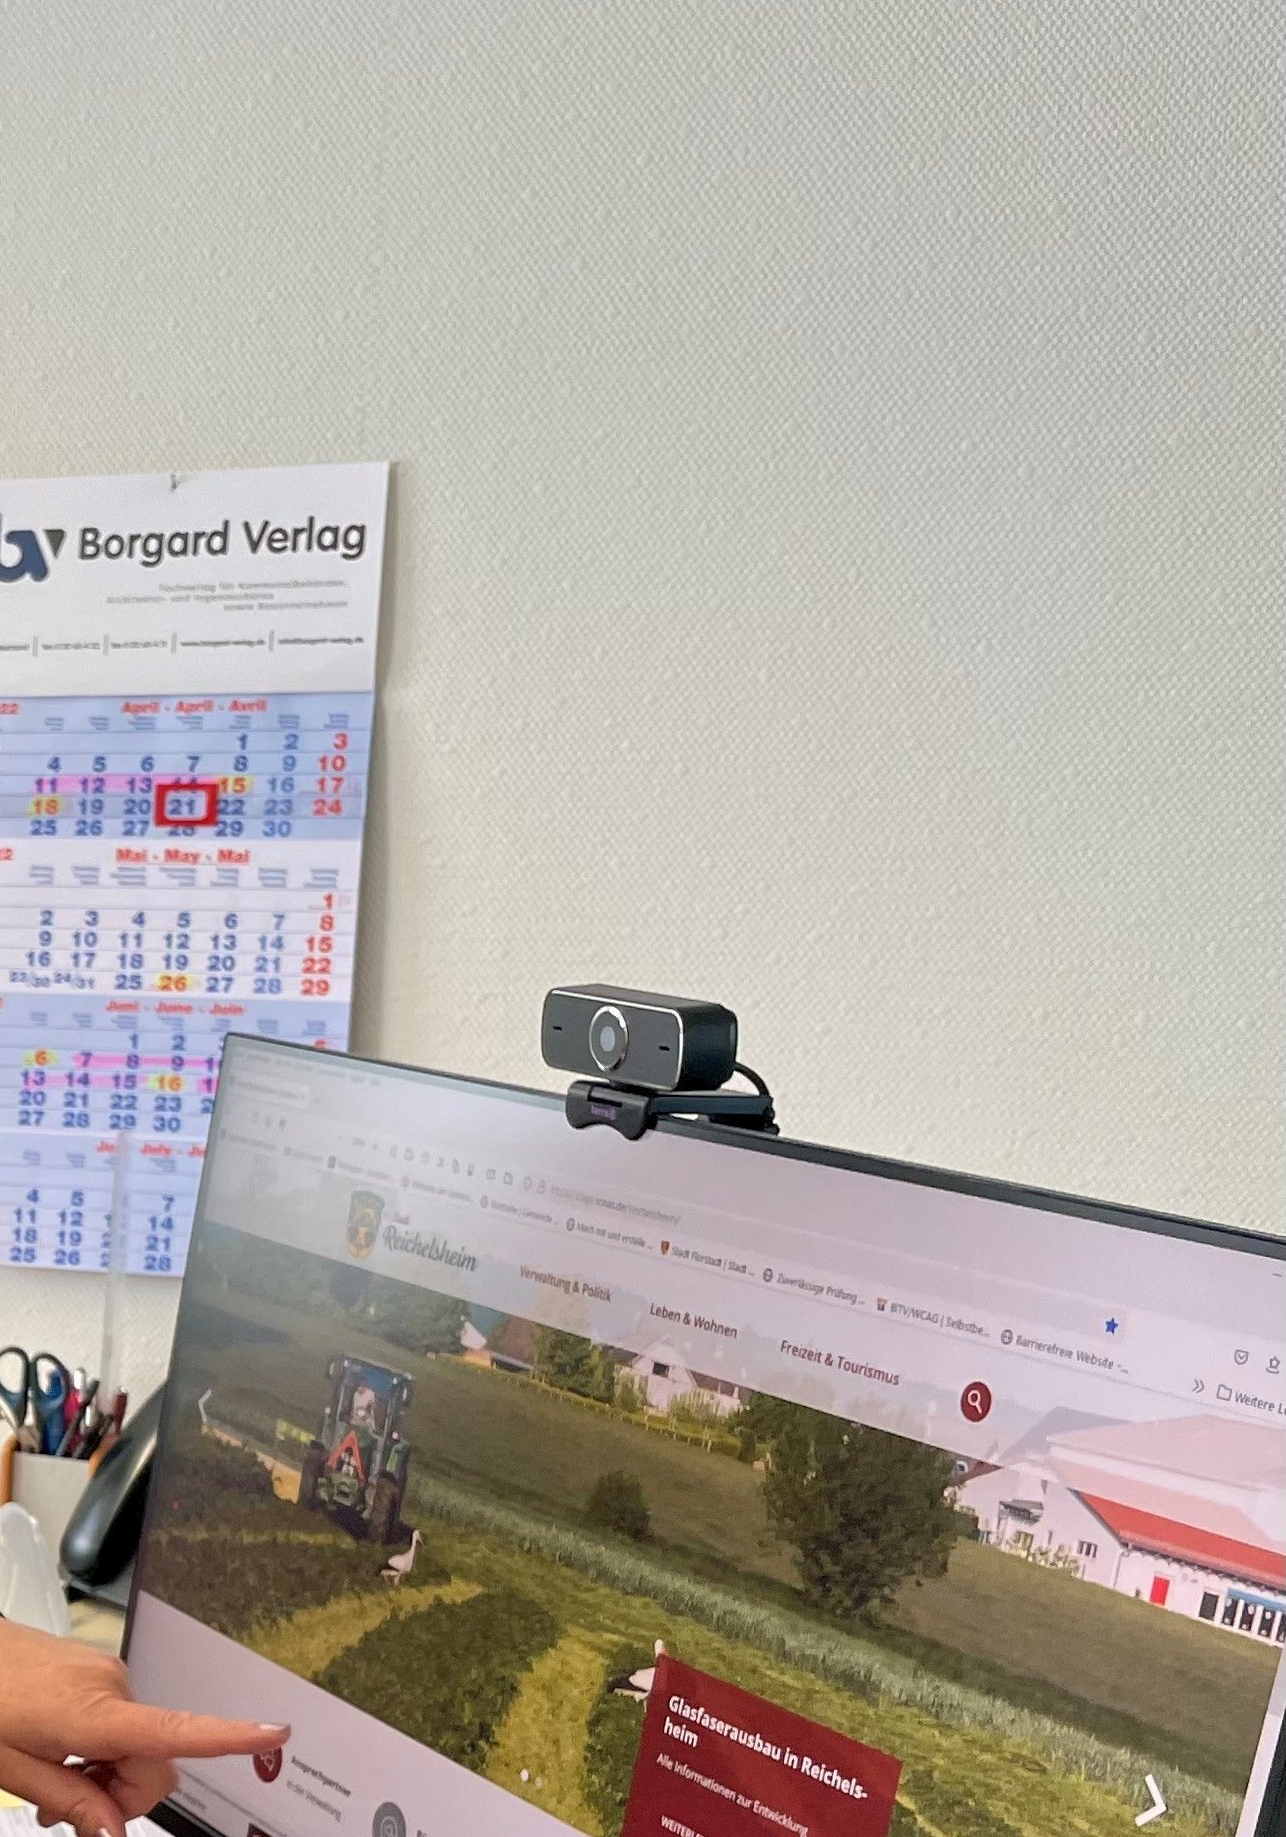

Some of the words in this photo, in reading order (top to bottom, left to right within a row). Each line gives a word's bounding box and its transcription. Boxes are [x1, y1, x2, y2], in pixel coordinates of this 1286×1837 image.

[78, 520, 230, 568] Borgard
[243, 515, 367, 560] Verlag
[122, 701, 159, 718] April
[176, 700, 214, 716] April
[230, 699, 268, 712] Avril
[236, 734, 248, 751] 1
[284, 733, 300, 751] 2
[333, 733, 349, 750] 3
[47, 756, 62, 773] 4
[93, 756, 107, 773] 5
[140, 756, 156, 773] 6
[187, 756, 201, 773] 7
[233, 755, 249, 773] 8
[282, 755, 297, 772] 9
[317, 755, 347, 771] 10
[34, 777, 59, 794] 11
[80, 777, 105, 794] 12
[128, 777, 153, 794] 13
[219, 777, 246, 794] 15
[268, 777, 295, 794] 16
[317, 777, 345, 794] 17
[33, 798, 59, 816] 18
[79, 798, 104, 816] 19
[124, 798, 151, 816] 20
[168, 799, 196, 816] 21
[218, 799, 246, 816] 22
[264, 799, 293, 816] 23
[313, 799, 343, 817] 24
[30, 819, 58, 837] 25
[75, 820, 103, 837] 26
[122, 820, 150, 837] 27
[215, 820, 244, 837] 29
[263, 820, 292, 837] 30
[116, 848, 148, 862] Mai
[165, 848, 200, 865] May
[217, 847, 251, 863] Mai
[324, 894, 335, 909] 1
[40, 910, 54, 927] 2
[85, 910, 99, 927] 3
[132, 912, 146, 928] 4
[177, 912, 191, 928] 5
[223, 913, 238, 929] 6
[272, 914, 285, 931] 7
[319, 915, 334, 931] 8
[39, 931, 52, 947] 9
[72, 932, 98, 948] 10
[119, 933, 143, 949] 11
[163, 933, 190, 950] 12
[210, 934, 237, 950] 13
[257, 935, 284, 952] 14
[305, 936, 333, 953] 15
[26, 951, 52, 967] 16
[72, 952, 96, 968] 17
[118, 953, 143, 970] 18
[162, 954, 189, 970] 19
[207, 955, 236, 972] 20
[254, 956, 282, 973] 21
[302, 957, 332, 974] 22
[115, 974, 142, 990] 25
[159, 975, 187, 991] 26
[205, 976, 234, 993] 27
[253, 978, 282, 995] 28
[300, 979, 329, 996] 29
[106, 1000, 140, 1013] Juni
[154, 1002, 193, 1015] June
[128, 1033, 139, 1049] 1
[171, 1035, 185, 1051] 2
[34, 1050, 47, 1066] 6
[80, 1052, 92, 1068] 7
[126, 1053, 140, 1069] 8
[170, 1055, 185, 1071] 9
[21, 1069, 46, 1086] 13
[66, 1071, 90, 1088] 14
[112, 1073, 137, 1090] 15
[157, 1075, 182, 1092] 16
[18, 1090, 45, 1107] 20
[63, 1092, 89, 1108] 21
[109, 1094, 137, 1110] 22
[154, 1096, 182, 1113] 23
[17, 1110, 45, 1127] 27
[62, 1112, 90, 1128] 28
[109, 1114, 136, 1131] 29
[153, 1116, 181, 1133] 30
[141, 1143, 173, 1158] July
[26, 1188, 39, 1203] 4
[70, 1190, 84, 1206] 5
[162, 1196, 174, 1212] 7
[13, 1208, 37, 1224] 11
[58, 1210, 83, 1227] 12
[148, 1215, 174, 1231] 14
[12, 1227, 37, 1243] 18
[57, 1230, 82, 1246] 19
[144, 1235, 171, 1252] 21
[383, 1224, 478, 1272] Reichelsheim
[9, 1246, 37, 1263] 25
[53, 1249, 80, 1266] 26
[143, 1255, 171, 1272] 28
[520, 1265, 571, 1295] Verwaltung
[572, 1281, 580, 1294] &
[581, 1283, 611, 1302] Politik
[650, 1303, 681, 1323] Leben
[682, 1312, 691, 1325] &
[694, 1315, 738, 1339] Wohnen
[780, 1340, 823, 1363] Freizeit
[824, 1353, 834, 1367] &
[837, 1356, 900, 1386] Tourismus
[1016, 1335, 1073, 1360] Barrierefreie
[1076, 1350, 1114, 1370] Website
[1235, 1391, 1275, 1412] Weitere
[663, 1717, 698, 1748] heim
[669, 1696, 781, 1760] Glasfaserausbau
[783, 1747, 798, 1769] in
[801, 1757, 868, 1799] Reichels-
[656, 1753, 673, 1771] Alle
[674, 1761, 736, 1800] Informationen
[737, 1793, 752, 1809] zur
[753, 1800, 809, 1837] Entwicklung
